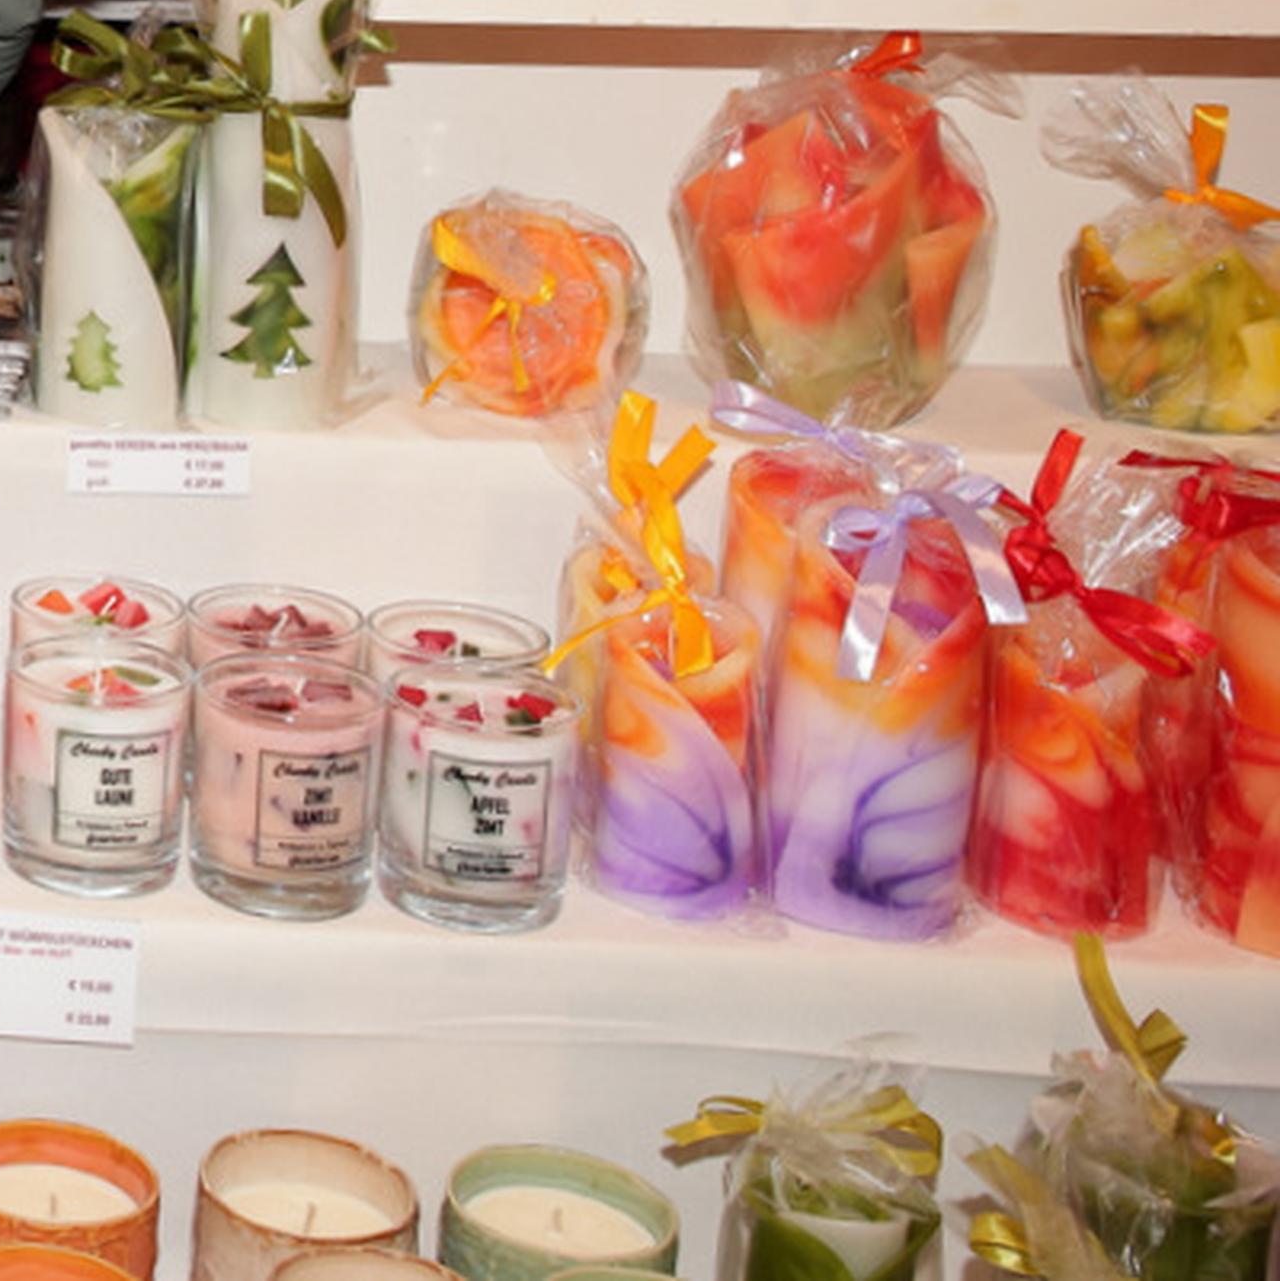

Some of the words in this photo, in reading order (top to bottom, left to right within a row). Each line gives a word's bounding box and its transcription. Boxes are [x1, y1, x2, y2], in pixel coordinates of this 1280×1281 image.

[100, 768, 133, 785] GUTE
[95, 789, 134, 806] LAUNE
[470, 795, 510, 815] APFEL
[474, 819, 505, 836] ZIMT
